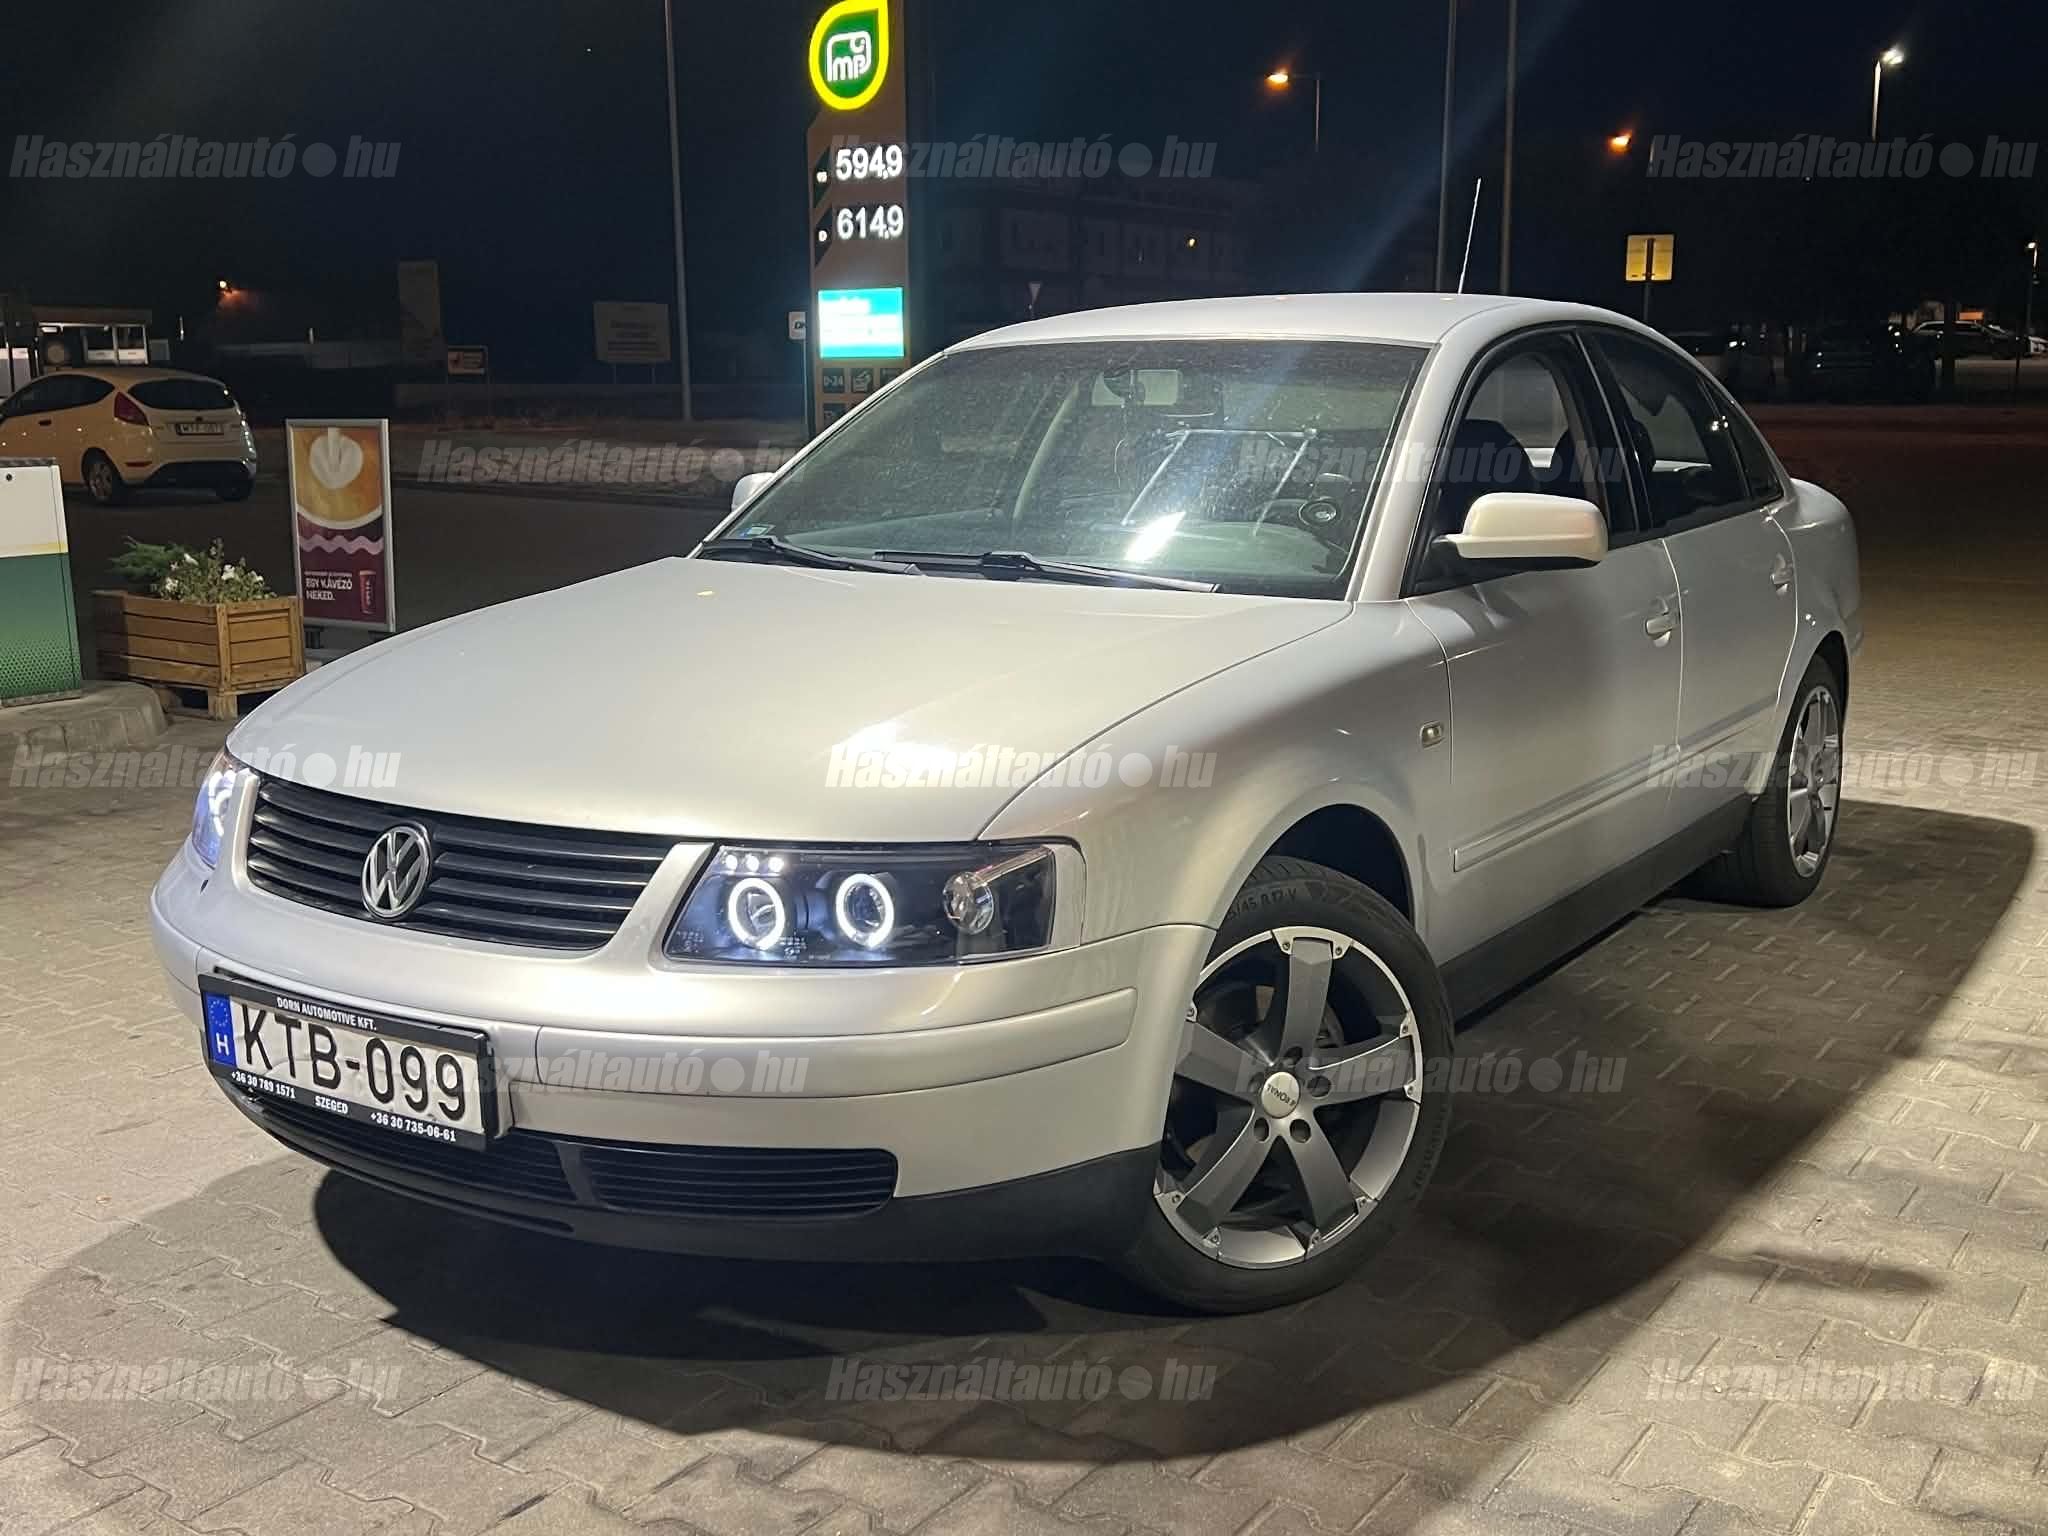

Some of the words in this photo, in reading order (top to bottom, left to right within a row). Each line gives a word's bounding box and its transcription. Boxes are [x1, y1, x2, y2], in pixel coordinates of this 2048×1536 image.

[836, 144, 903, 180] 594,9
[837, 204, 904, 240] 614,9
[277, 996, 301, 1012] DORN
[301, 1003, 356, 1026] AUTOMOTIVE
[357, 1017, 377, 1031] KFT.
[215, 1032, 230, 1056] H
[242, 1003, 466, 1122] KTB-099
[231, 1071, 246, 1084] +36
[247, 1074, 258, 1087] 30
[276, 1083, 296, 1099] 1571
[315, 1095, 348, 1114] SZEGED
[370, 1112, 388, 1125] +36
[390, 1115, 403, 1129] 30
